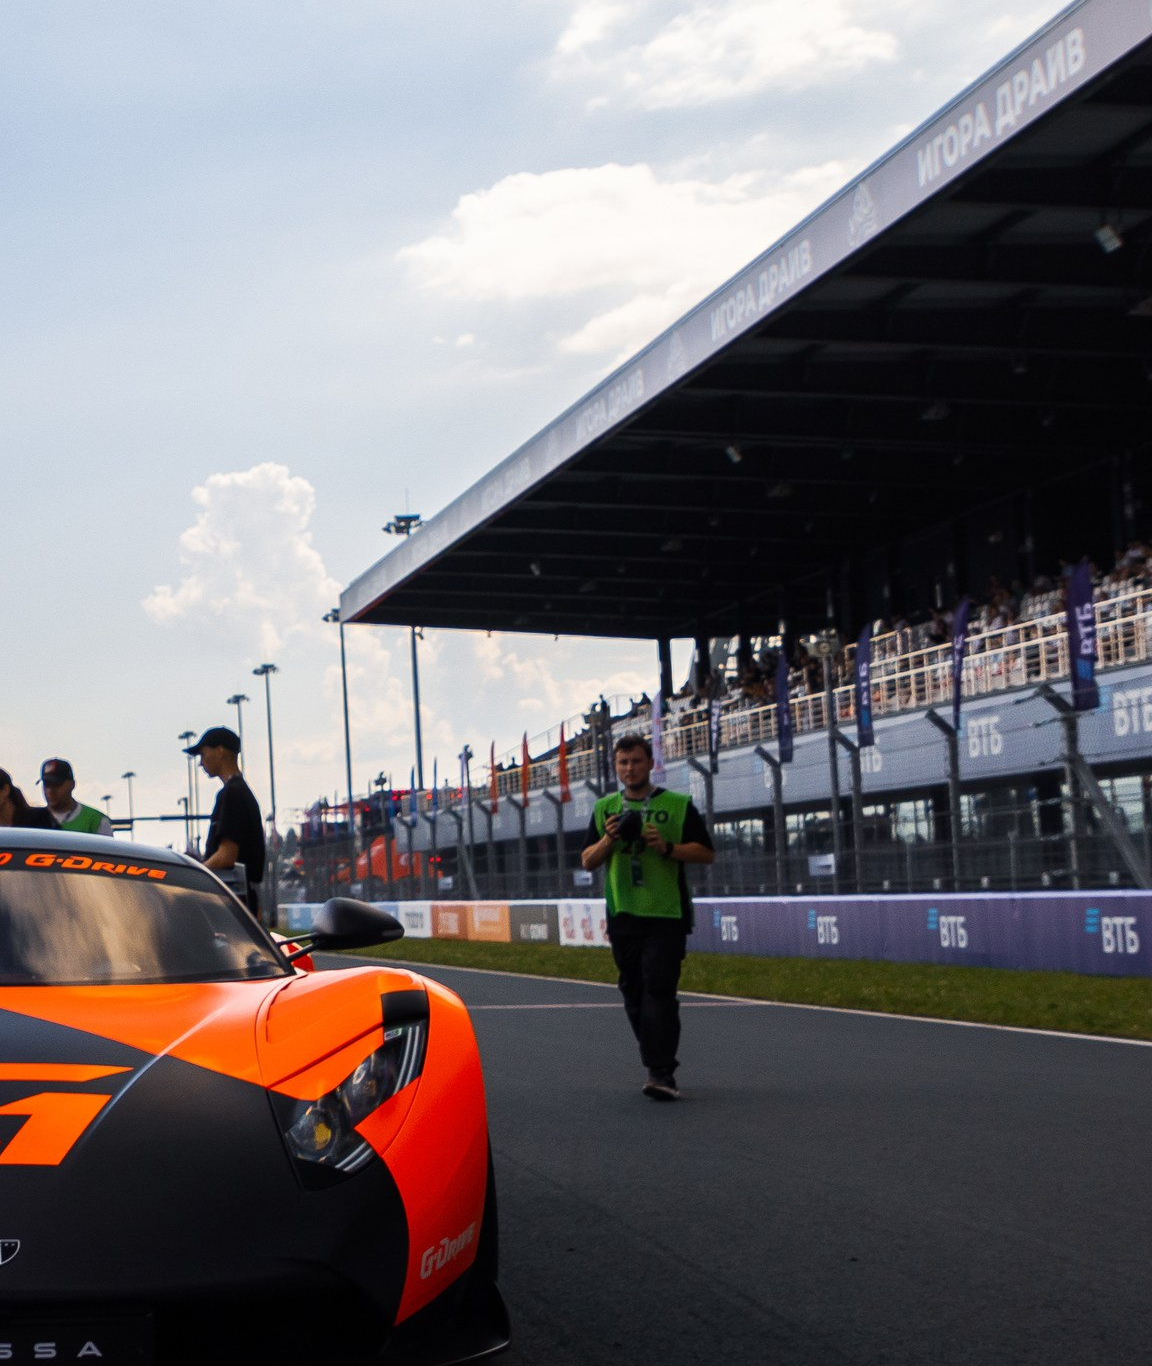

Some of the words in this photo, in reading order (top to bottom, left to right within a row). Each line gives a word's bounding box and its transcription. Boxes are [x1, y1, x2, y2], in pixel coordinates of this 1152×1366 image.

[917, 102, 992, 187] ИГОРА
[1075, 602, 1095, 655] ВТБ
[967, 716, 1003, 758] ВТБ
[816, 915, 840, 944] ВТБ
[939, 915, 968, 948] ВТБ
[1101, 916, 1139, 954] ВТБ
